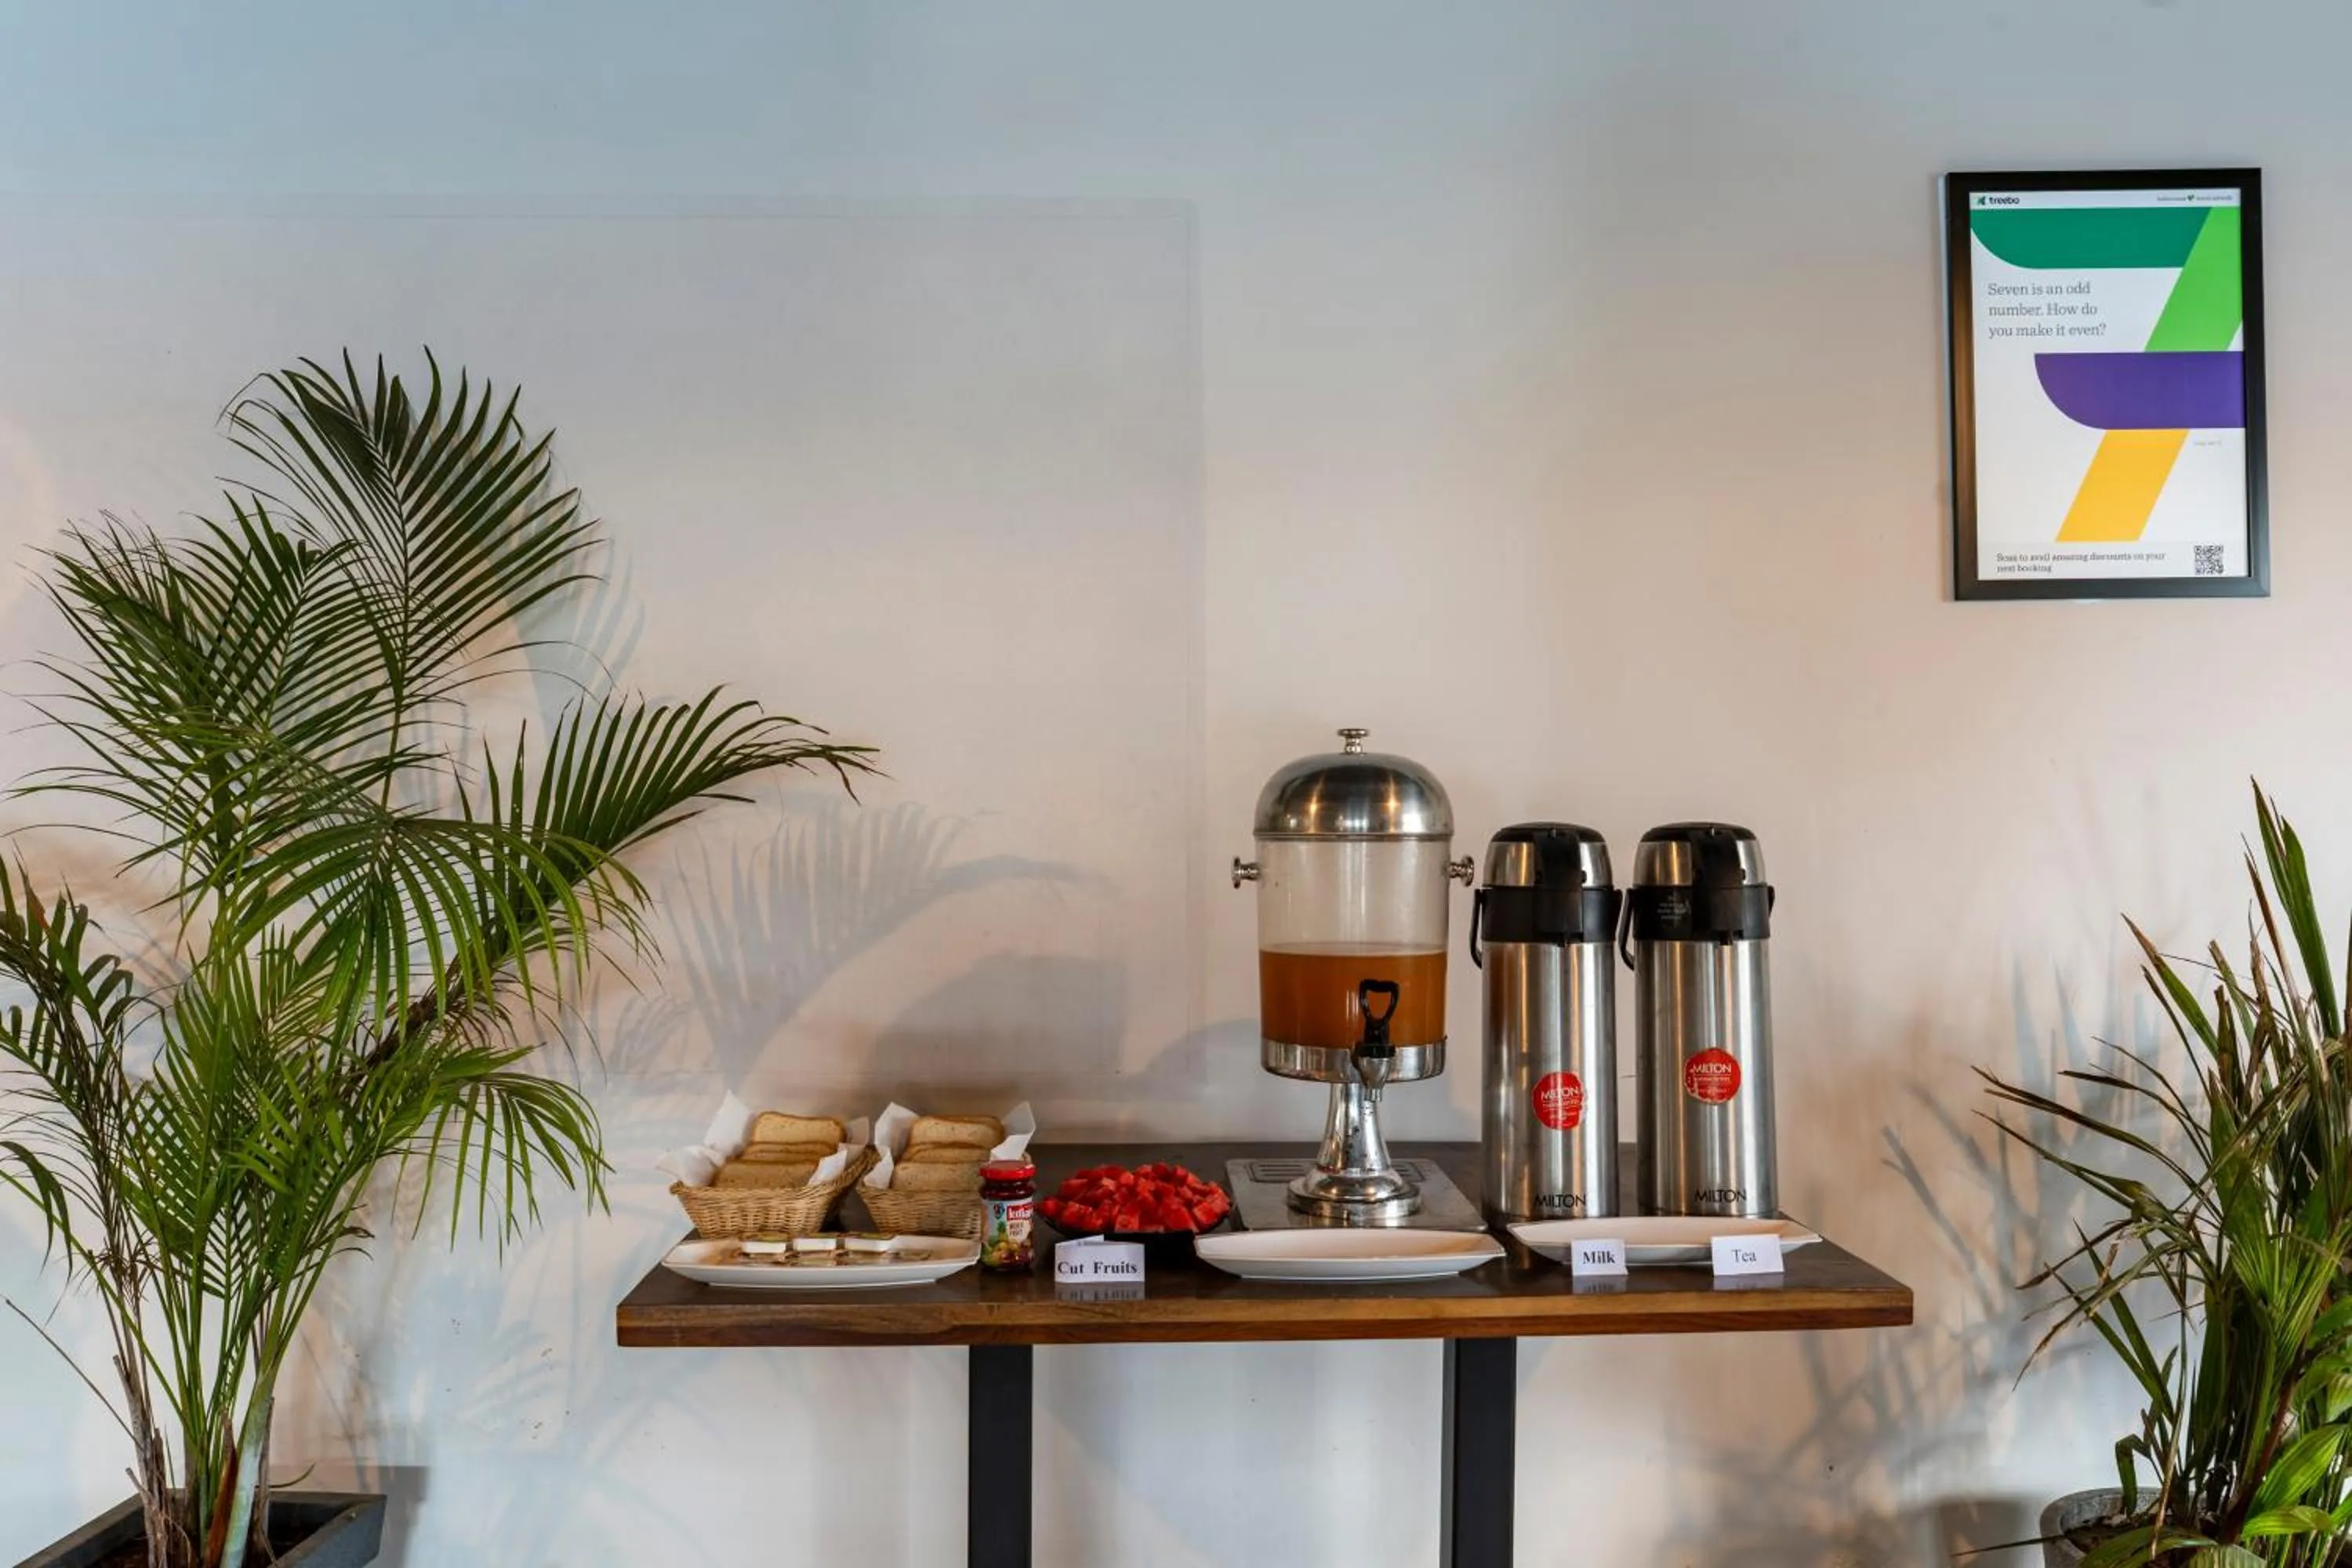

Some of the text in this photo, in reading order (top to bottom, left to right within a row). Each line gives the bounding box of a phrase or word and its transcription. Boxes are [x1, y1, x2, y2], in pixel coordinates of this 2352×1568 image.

[1989, 196, 2020, 205] treebo
[1987, 281, 2091, 296] Seven is an odd
[1988, 303, 2098, 316] number. How do
[1988, 322, 2107, 339] you make it even?
[2020, 553, 2028, 562] to
[2030, 552, 2050, 562] avail
[2053, 552, 2089, 564] amazing
[2090, 551, 2132, 562] discounts
[2133, 553, 2144, 561] on
[2146, 553, 2165, 563] your
[2017, 563, 2053, 574] booking
[1693, 1062, 1732, 1073] MILTON
[1534, 1193, 1587, 1208] MILTON
[1694, 1189, 1747, 1204] MILTON
[1582, 1250, 1616, 1265] Milk
[1730, 1248, 1757, 1263] Tea
[1058, 1261, 1083, 1274] Cut
